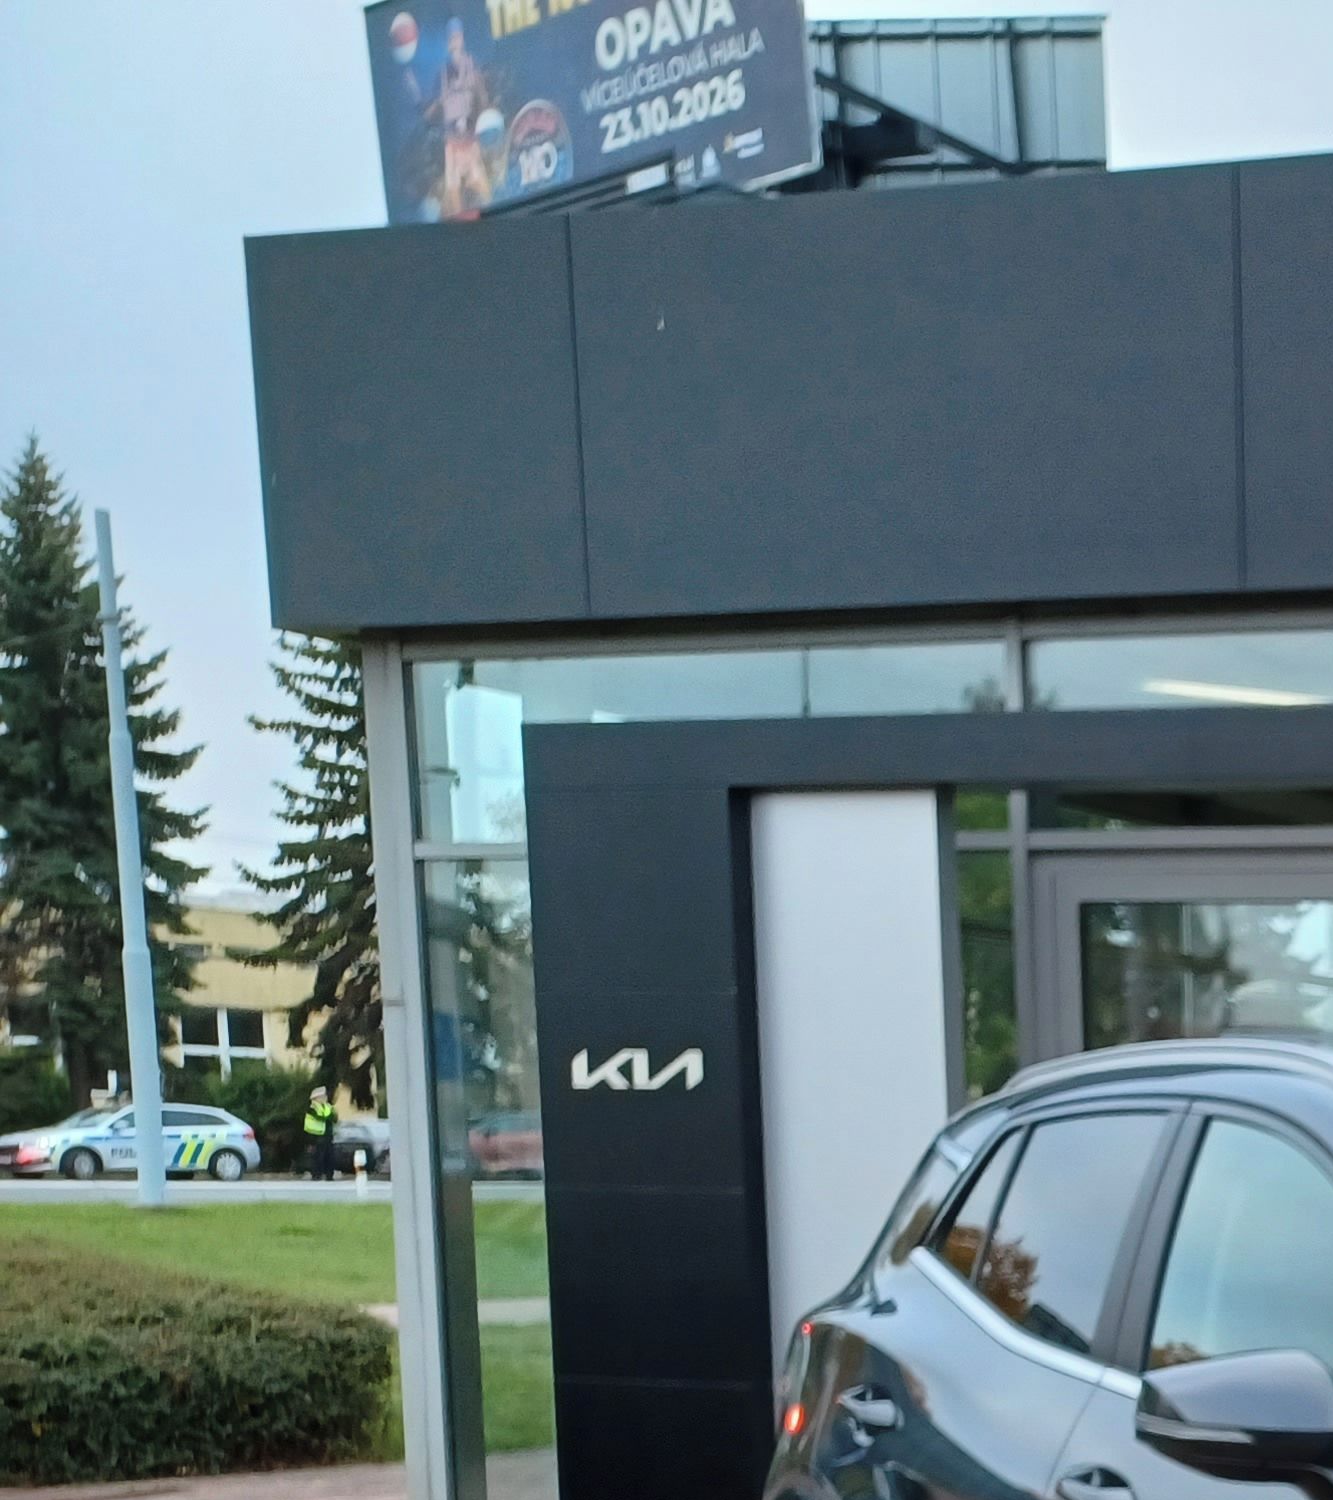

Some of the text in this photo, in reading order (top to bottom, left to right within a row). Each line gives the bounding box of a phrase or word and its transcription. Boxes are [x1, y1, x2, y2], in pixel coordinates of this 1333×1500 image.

[594, 0, 737, 70] OPAVA
[709, 27, 766, 68] HALA
[598, 67, 746, 154] 23.10.2026
[571, 1048, 704, 1090] KIA
